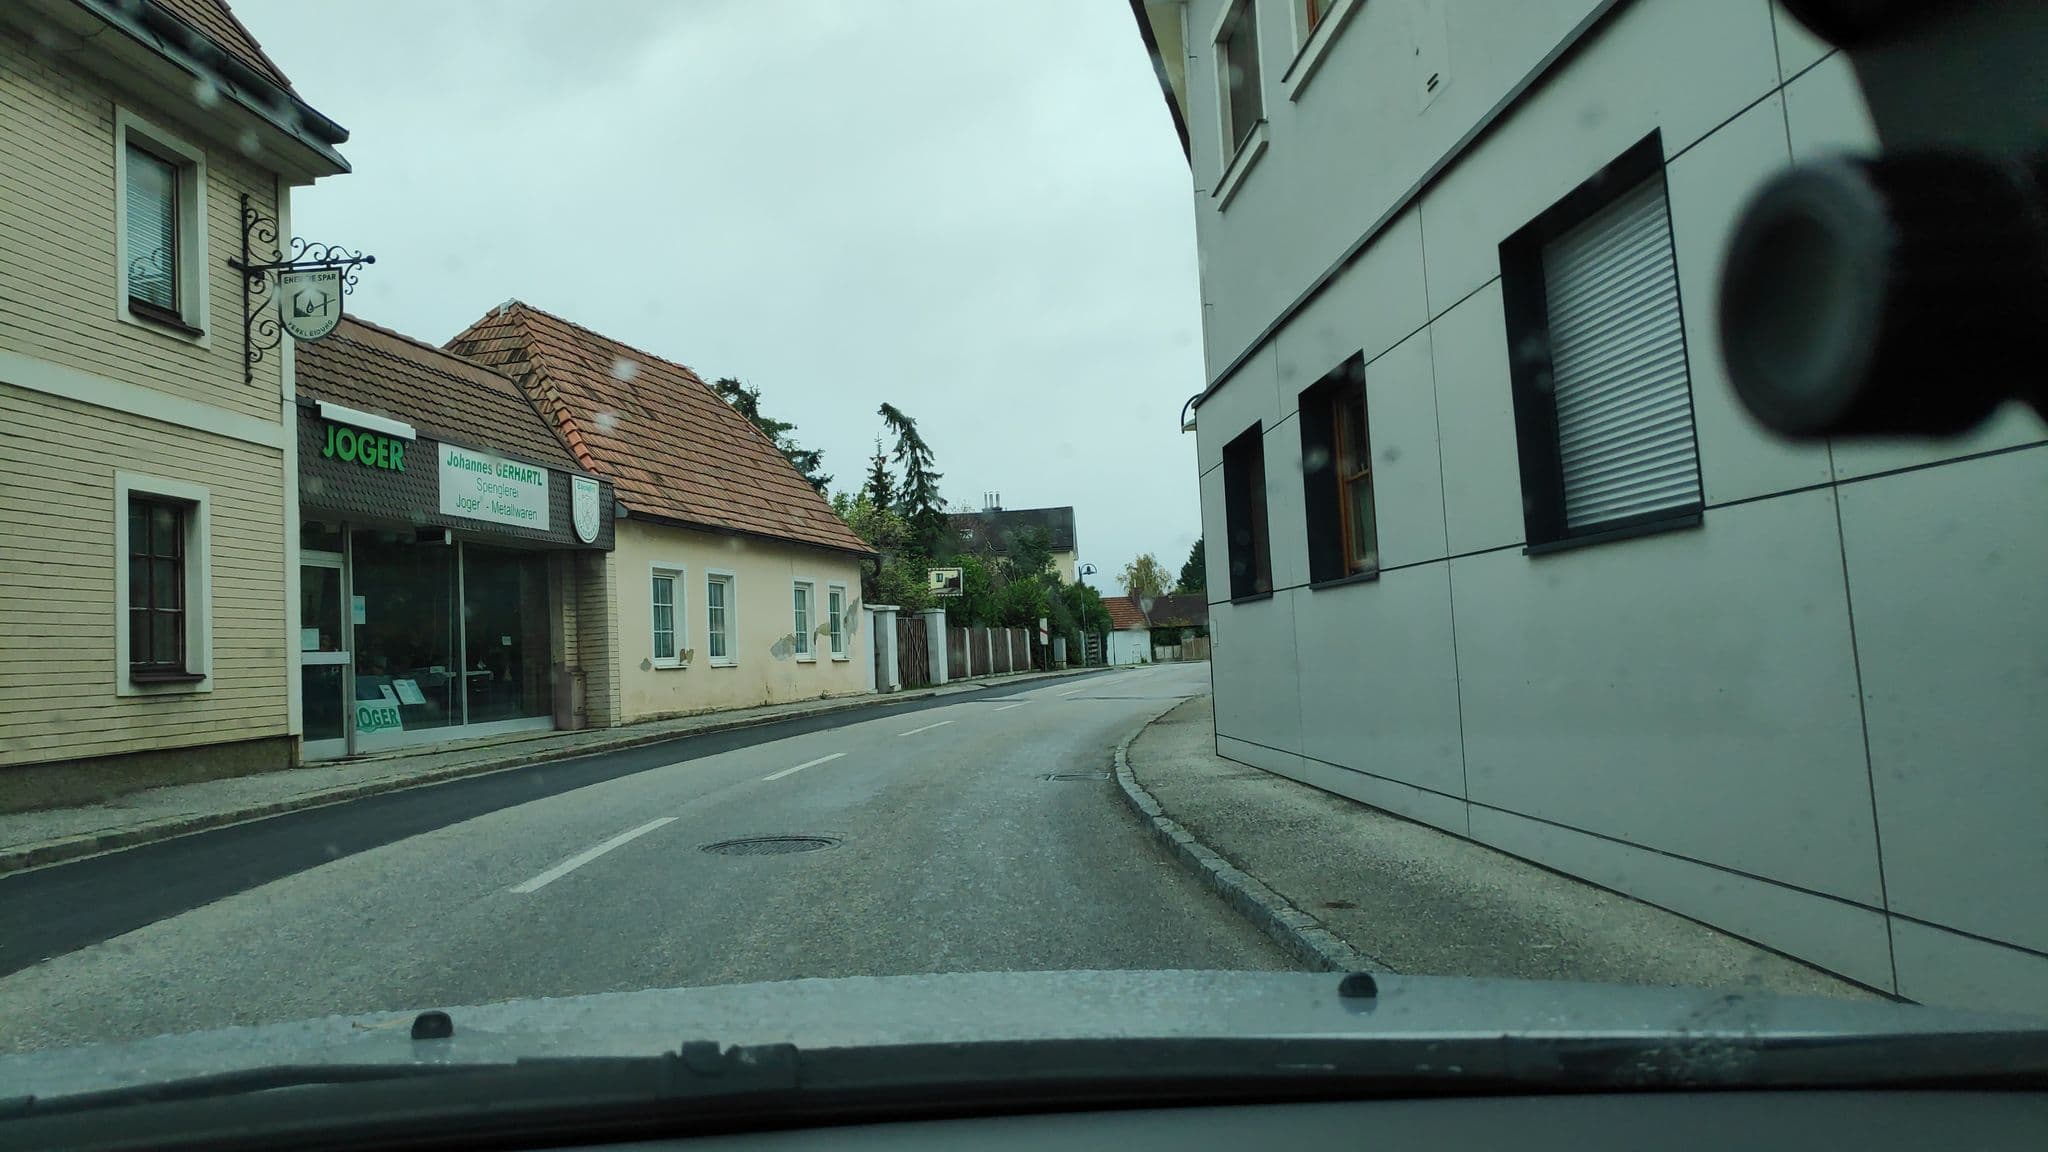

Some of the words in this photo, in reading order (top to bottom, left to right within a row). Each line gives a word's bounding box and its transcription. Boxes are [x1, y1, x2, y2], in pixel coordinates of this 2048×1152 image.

[317, 273, 337, 282] SPAR
[322, 424, 405, 472] JOGER
[447, 451, 493, 476] Johannes
[495, 462, 543, 487] GERHARTL
[476, 477, 520, 499] Spenglerei
[456, 494, 481, 513] Joger
[491, 500, 538, 521] Metallwaren
